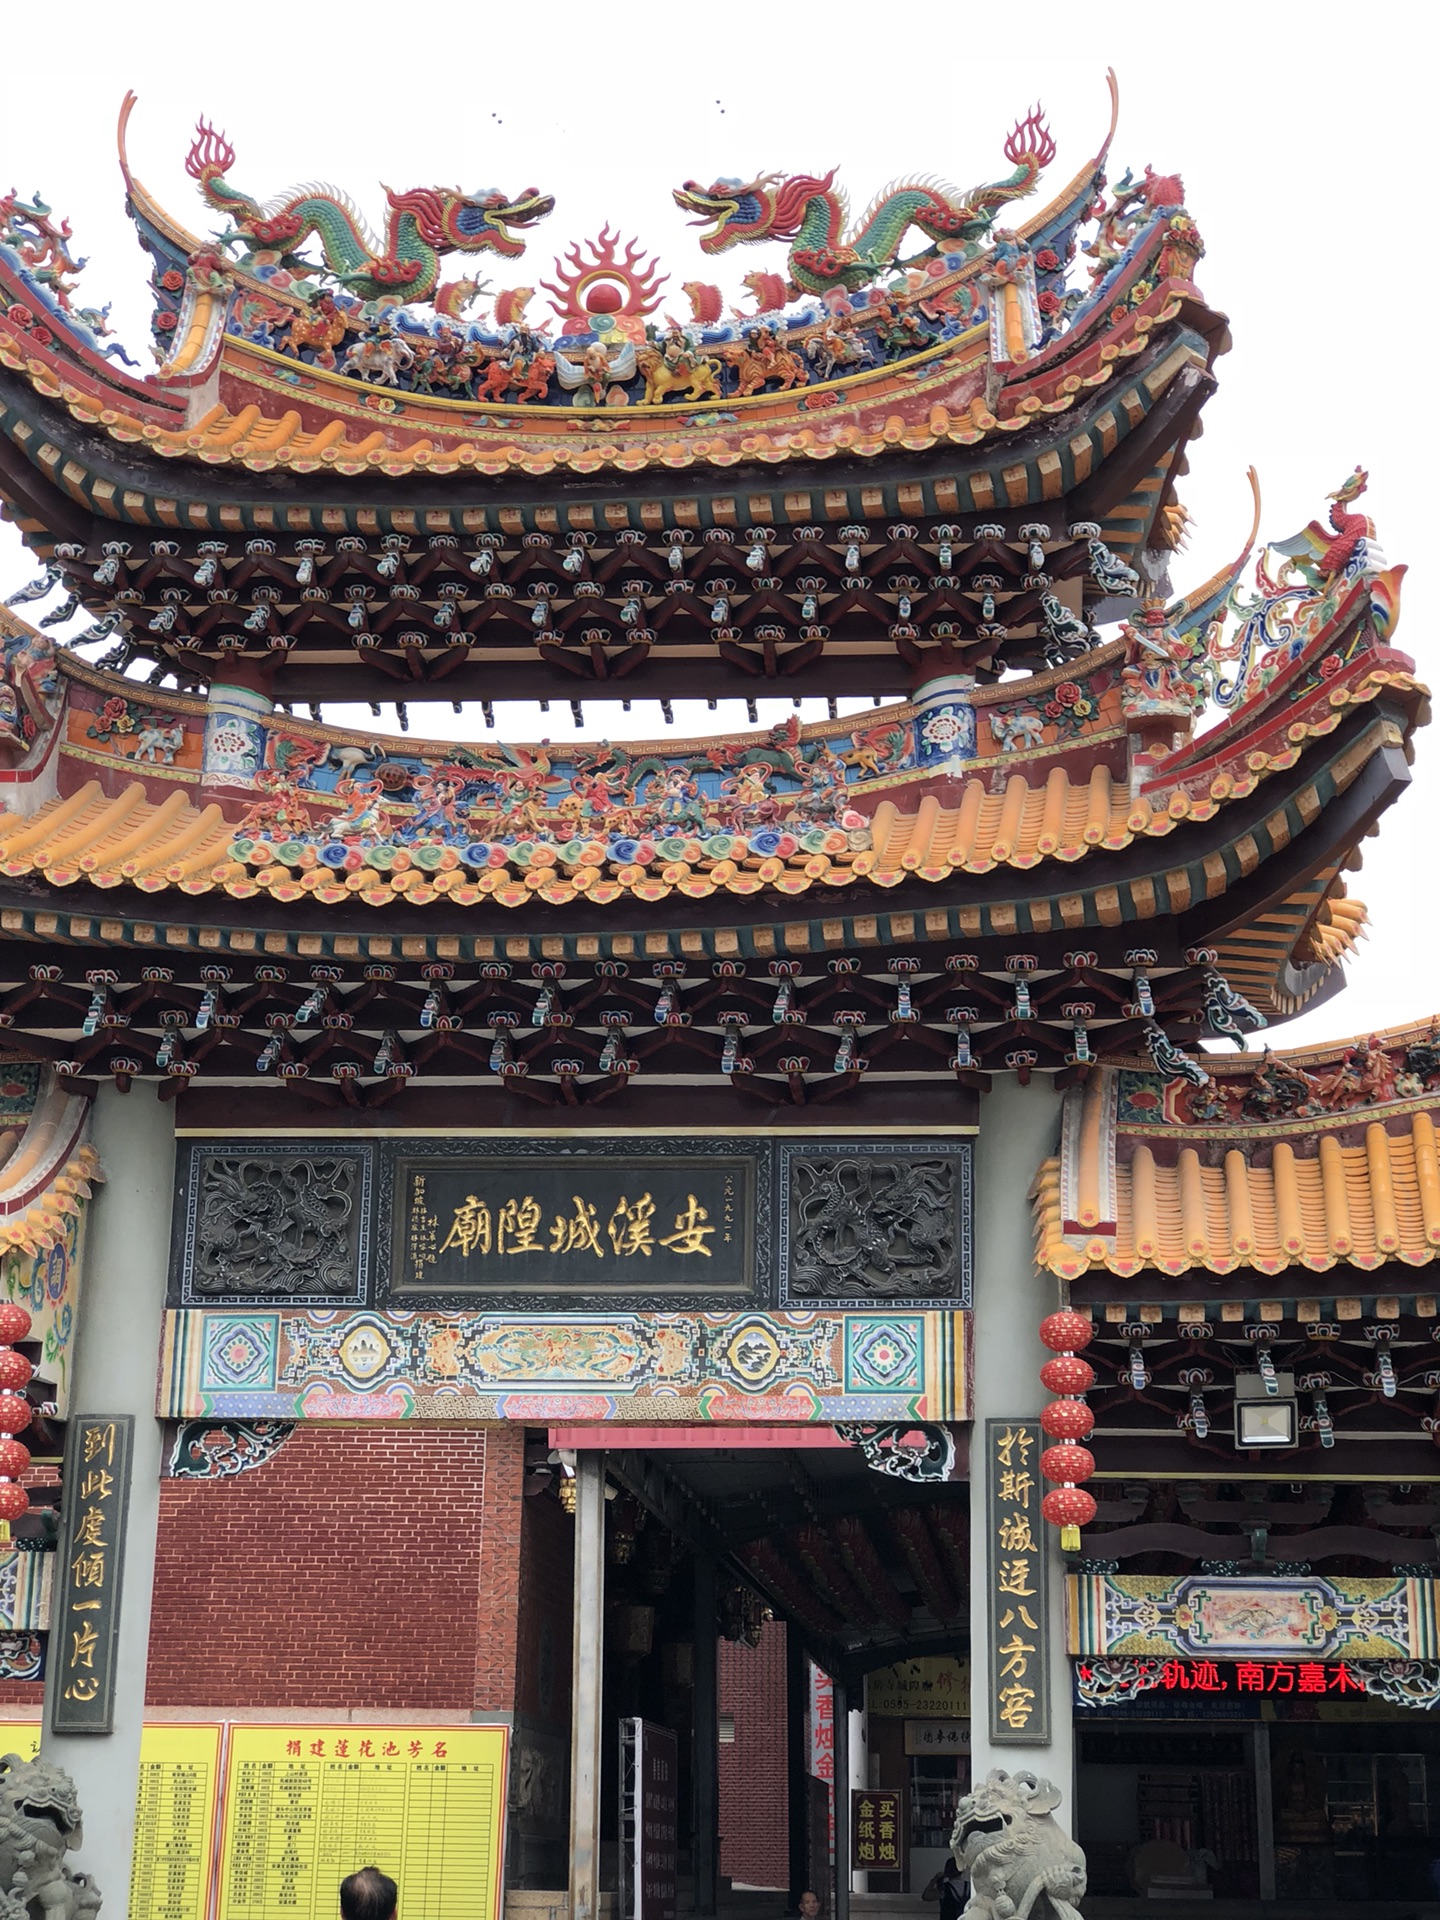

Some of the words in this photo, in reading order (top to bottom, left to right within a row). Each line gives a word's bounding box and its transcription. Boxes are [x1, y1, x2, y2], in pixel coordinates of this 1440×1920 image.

[858, 1801, 875, 1861] 金纸炮
[879, 1801, 896, 1861] 买香烛
